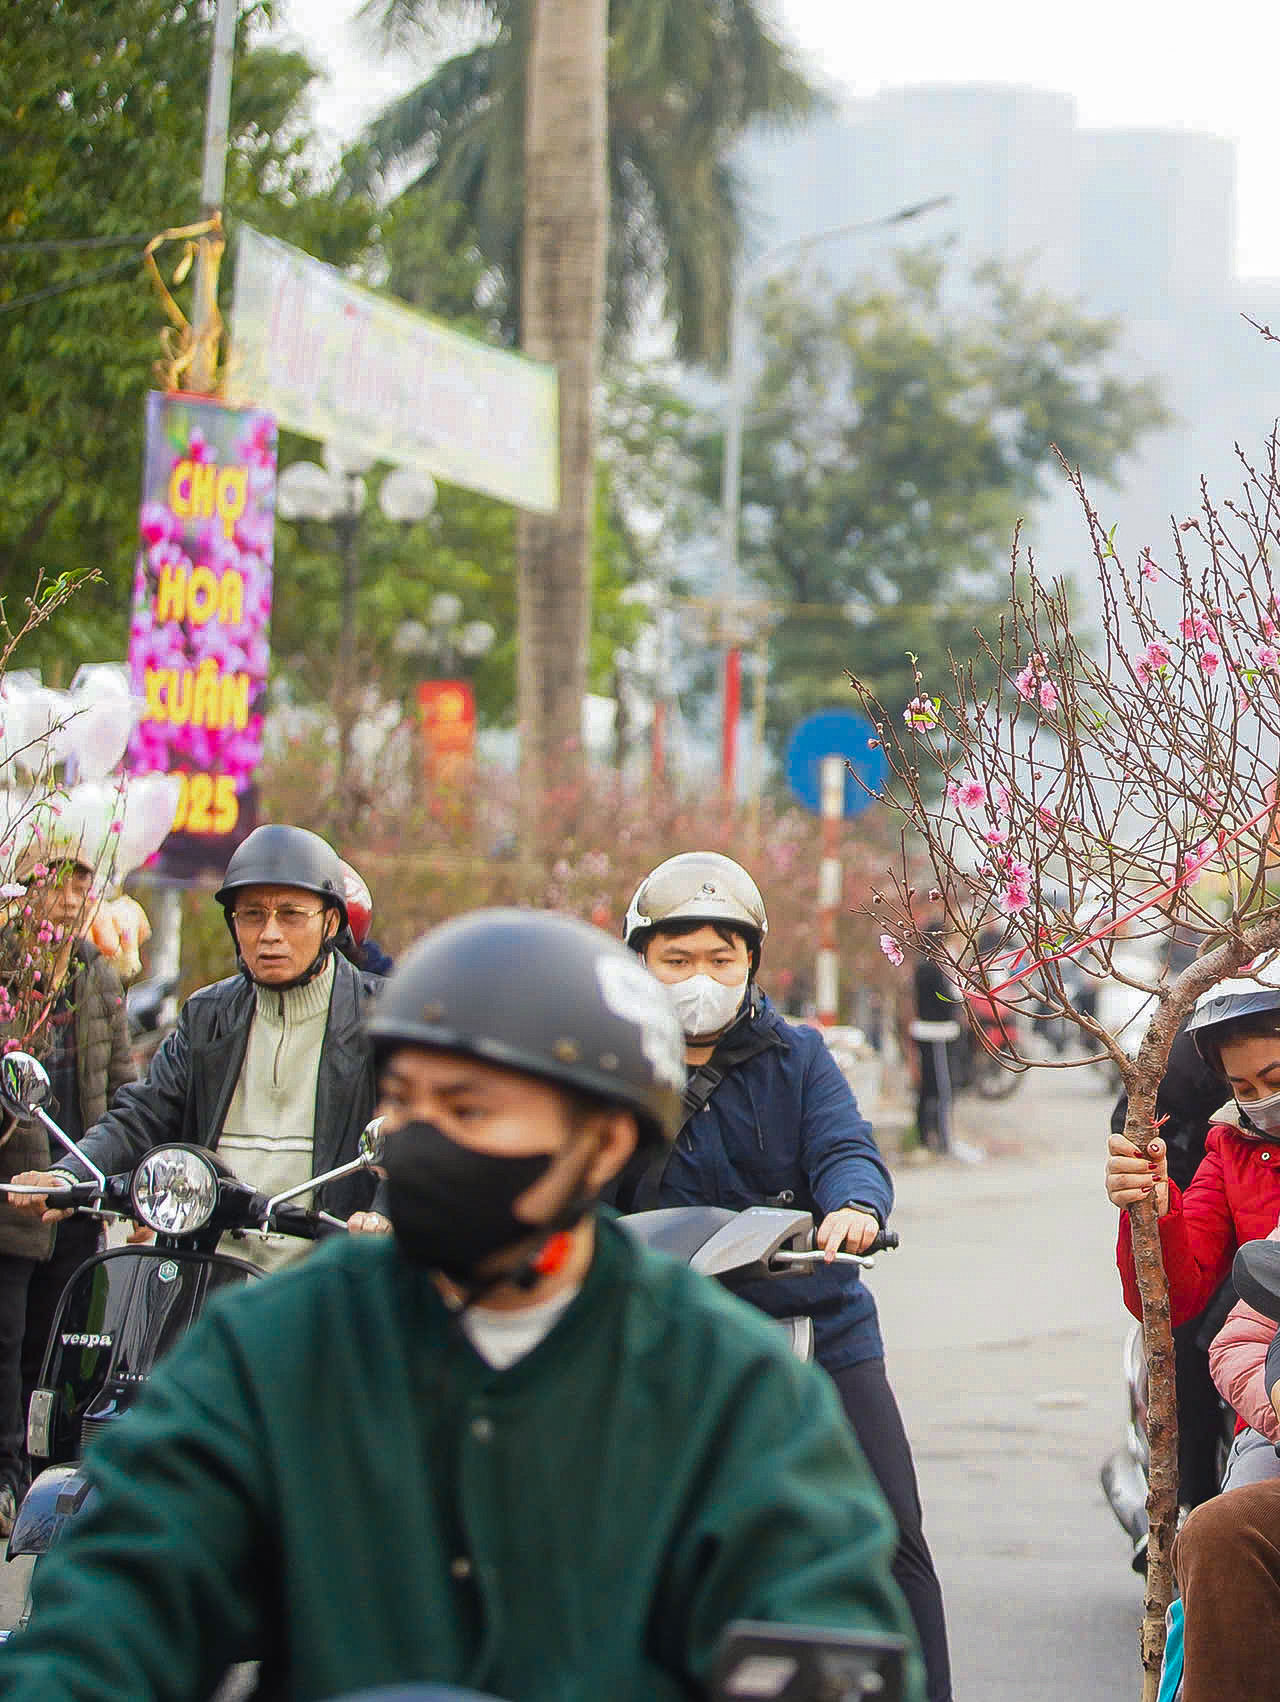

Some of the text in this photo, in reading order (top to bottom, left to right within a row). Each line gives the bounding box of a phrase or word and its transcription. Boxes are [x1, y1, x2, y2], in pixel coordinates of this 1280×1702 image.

[169, 460, 248, 540] CHỢ
[159, 566, 243, 623] HOA
[144, 658, 249, 729] XUÂN
[61, 1333, 112, 1347] vespa
